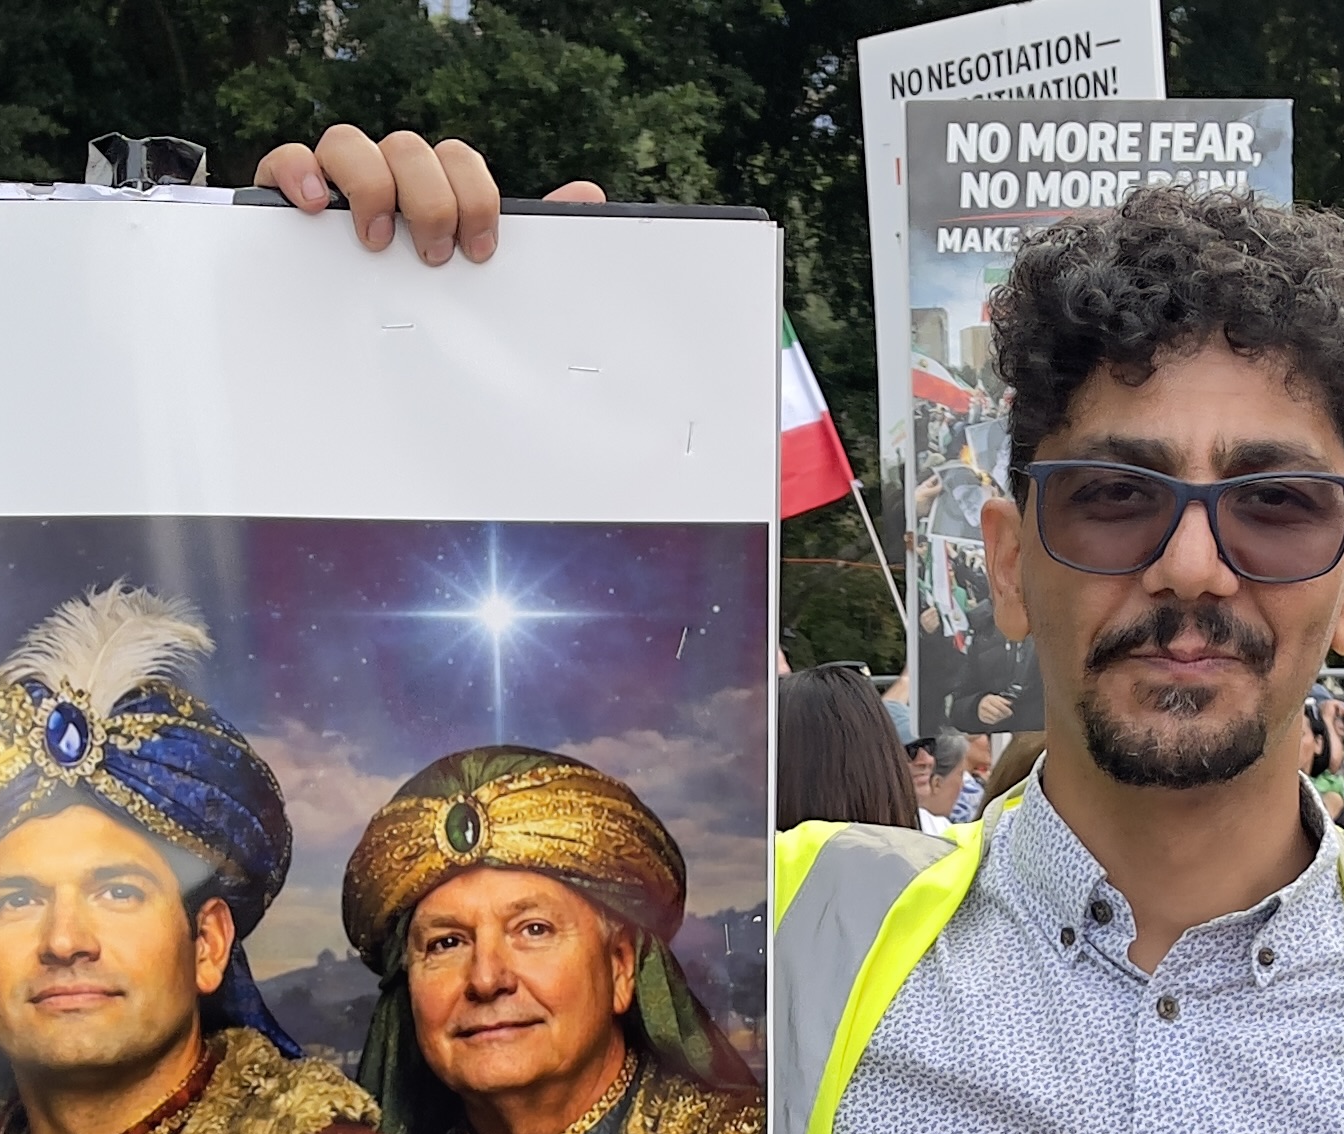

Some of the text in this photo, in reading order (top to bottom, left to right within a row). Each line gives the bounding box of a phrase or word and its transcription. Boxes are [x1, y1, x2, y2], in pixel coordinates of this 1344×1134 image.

[890, 68, 922, 99] NO
[947, 122, 1263, 167] NO MORE FEAR,
[960, 171, 1020, 208] NO
[1026, 170, 1141, 208] MORE
